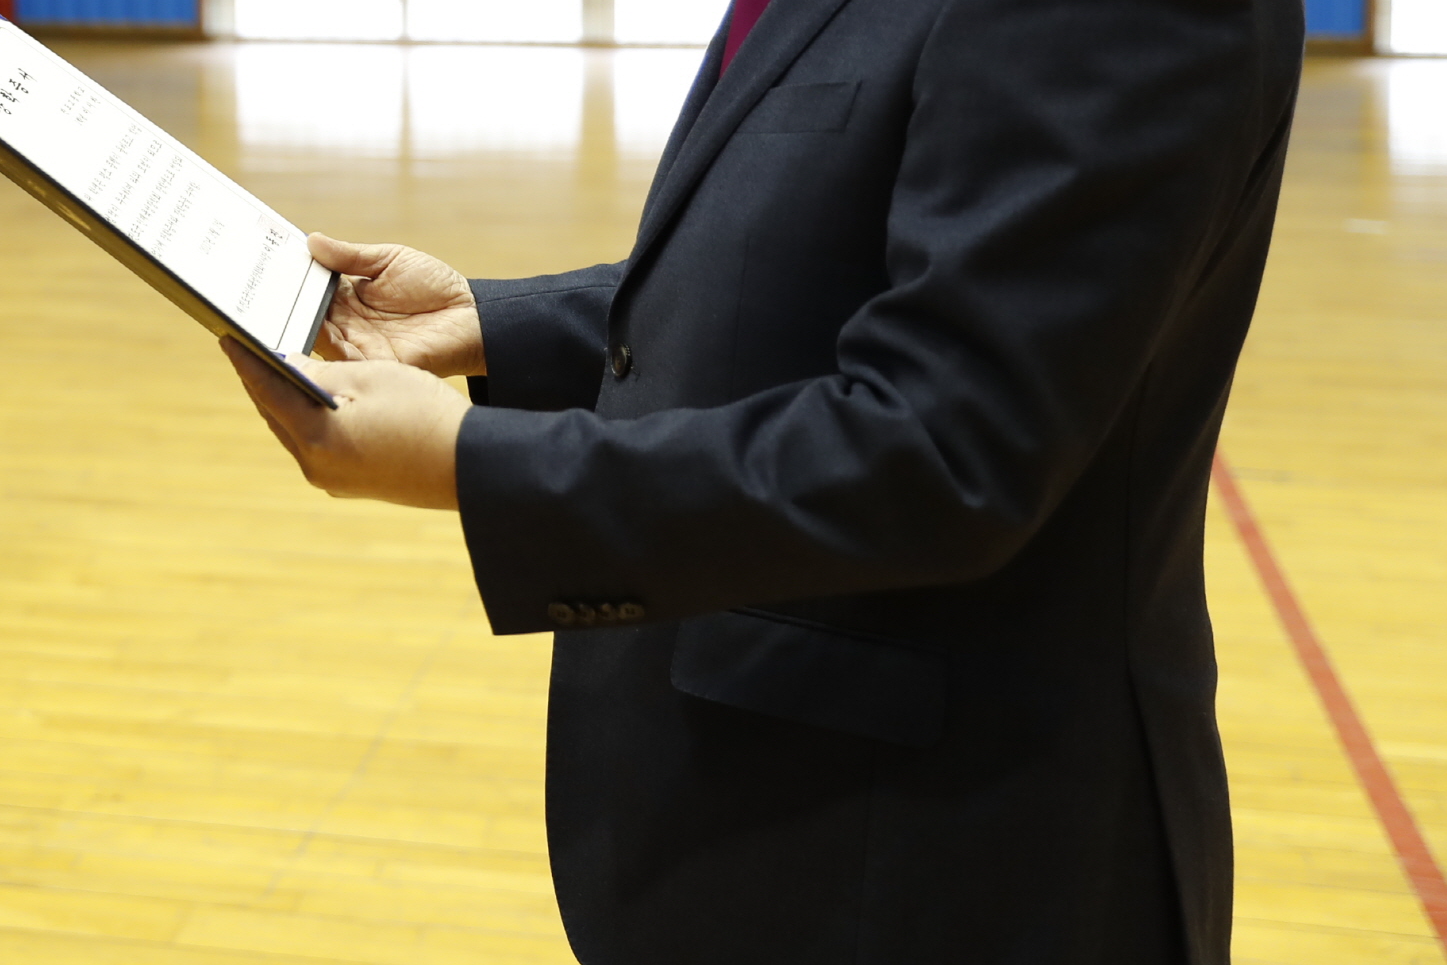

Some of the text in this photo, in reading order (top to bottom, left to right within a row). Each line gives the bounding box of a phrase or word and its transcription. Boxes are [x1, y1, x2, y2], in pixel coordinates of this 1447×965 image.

[87, 177, 107, 195] 학생은
[98, 167, 113, 181] 평소
[115, 134, 135, 155] 올바르고
[114, 181, 134, 205] 우수하여
[136, 154, 151, 174] 모범이
[146, 139, 163, 158] 되므로
[155, 169, 176, 195] 장학생으로
[159, 214, 179, 242] 장학증서와
[173, 195, 193, 218] 장학금을
